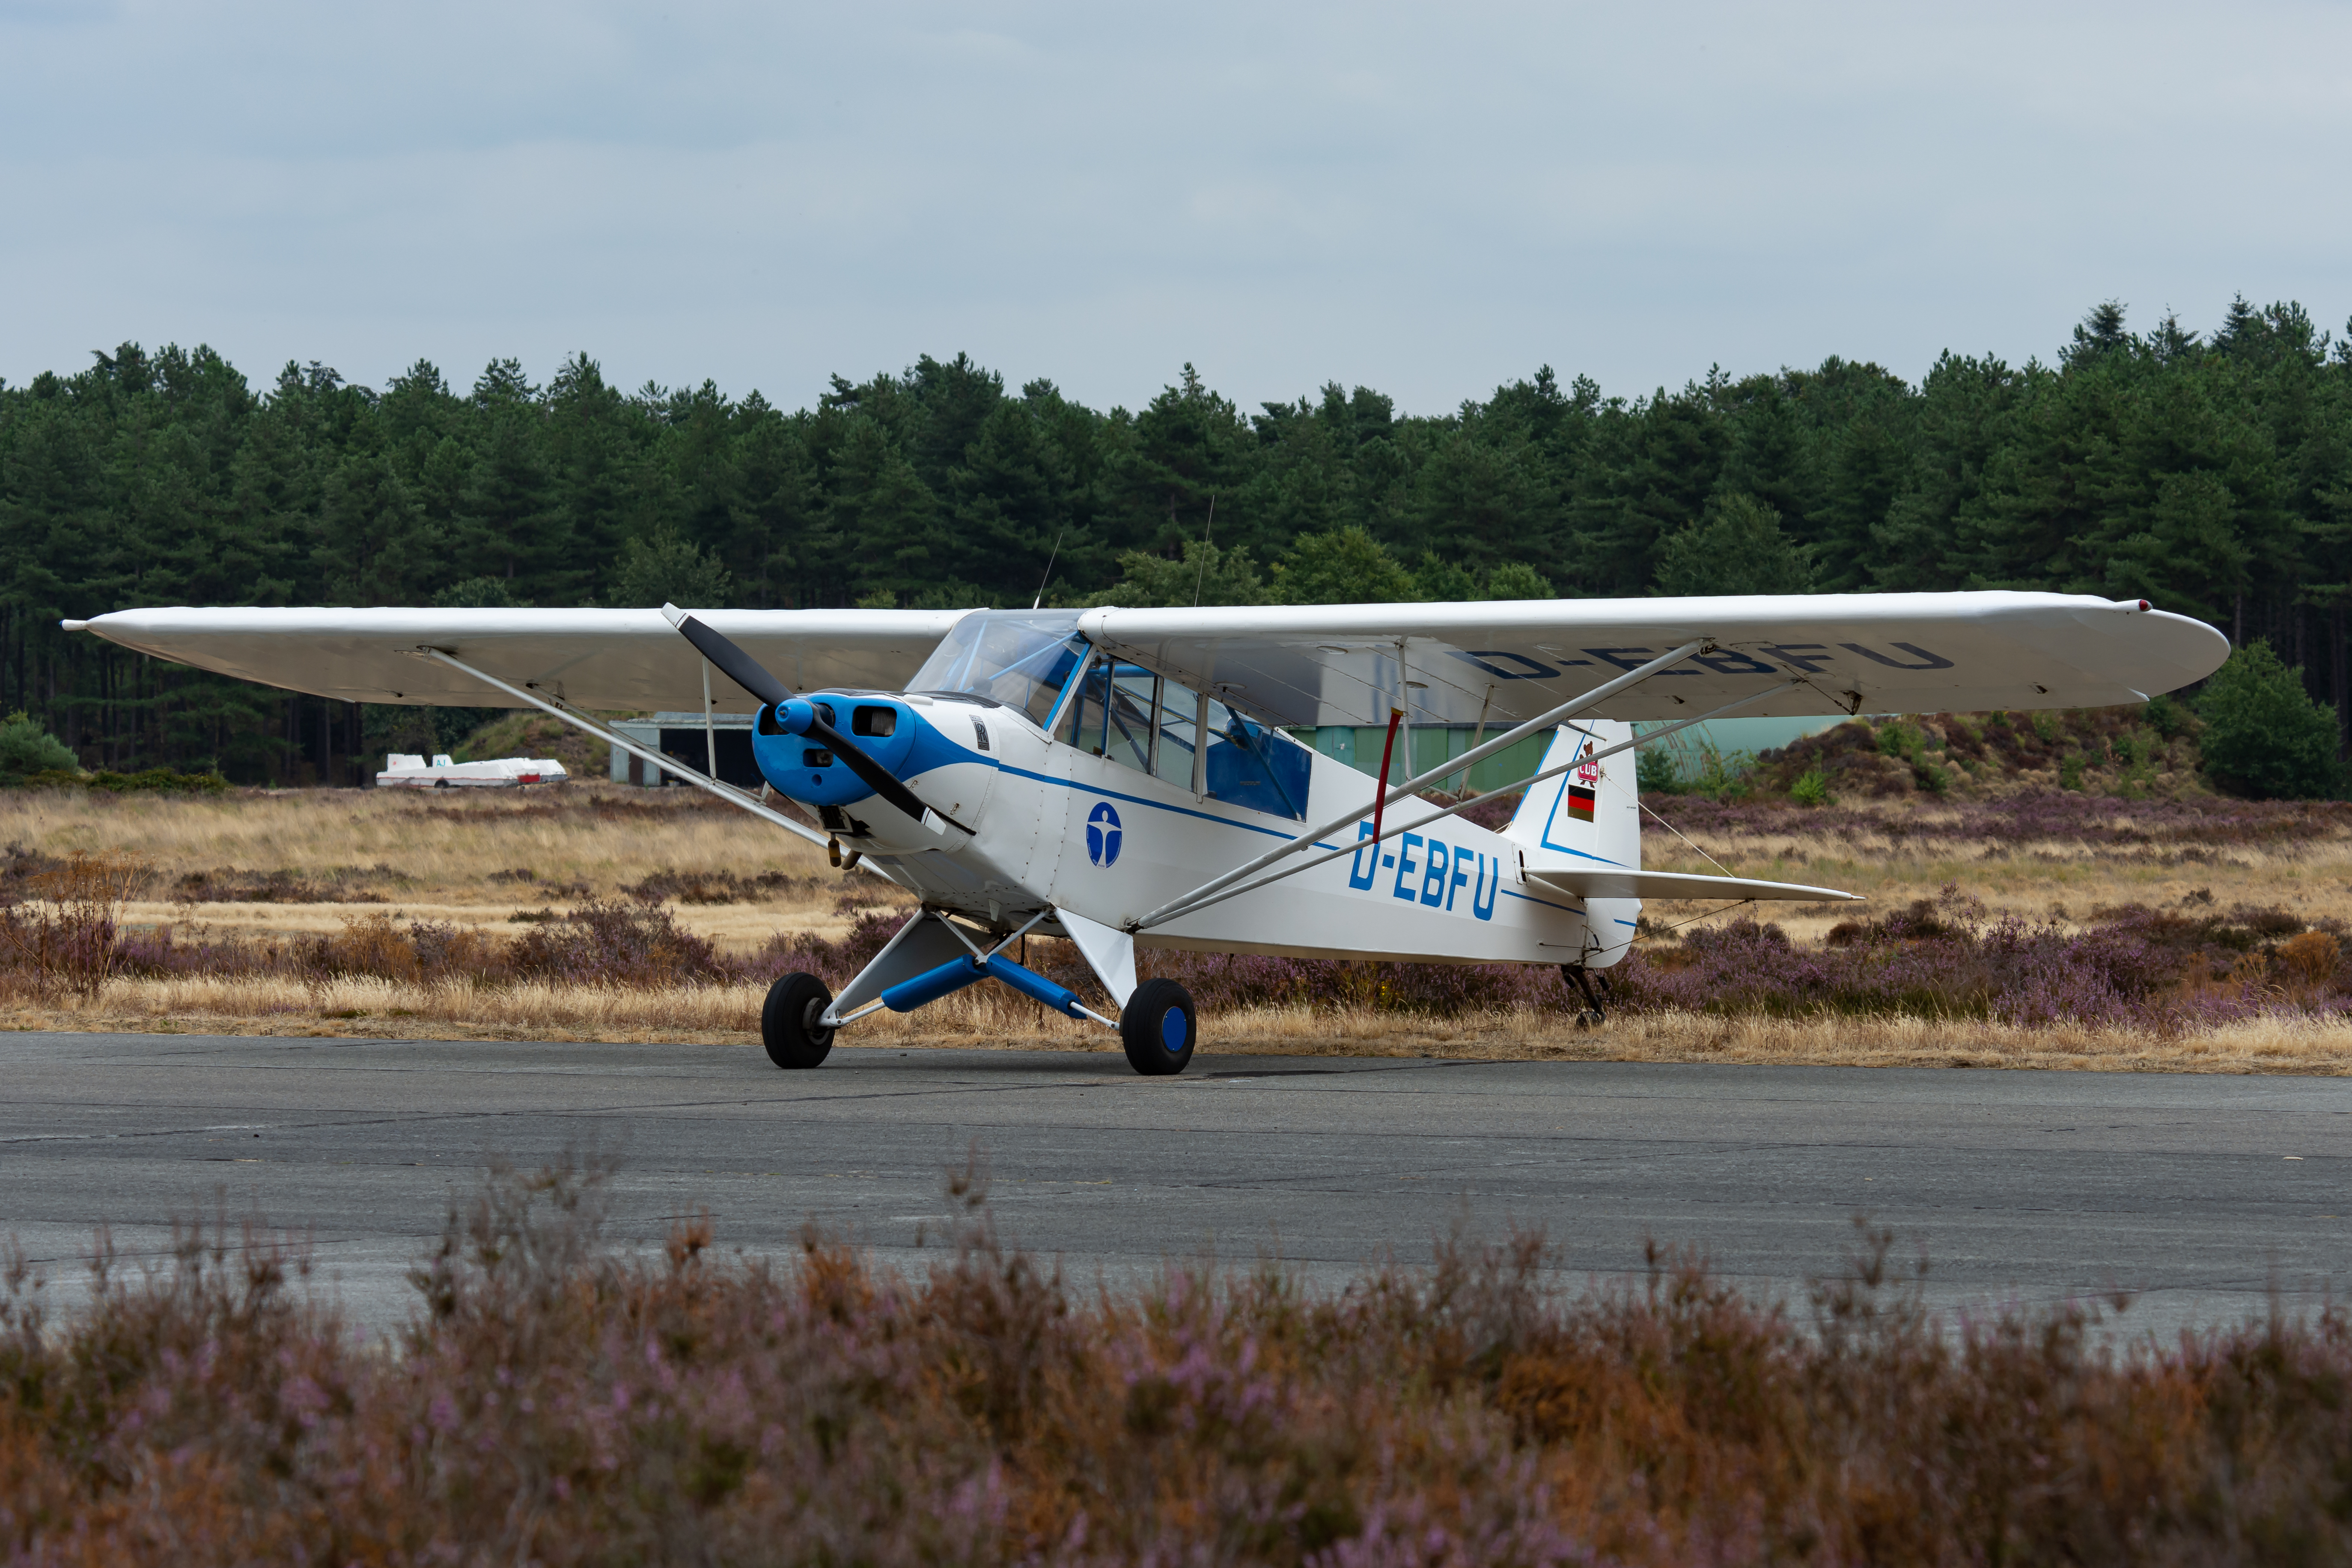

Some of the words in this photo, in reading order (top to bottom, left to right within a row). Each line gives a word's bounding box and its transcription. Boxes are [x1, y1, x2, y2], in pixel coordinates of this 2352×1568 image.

[1443, 643, 1955, 680] D-EBFU
[1579, 764, 1597, 776] CUB
[1349, 821, 1498, 921] D-EBFU
